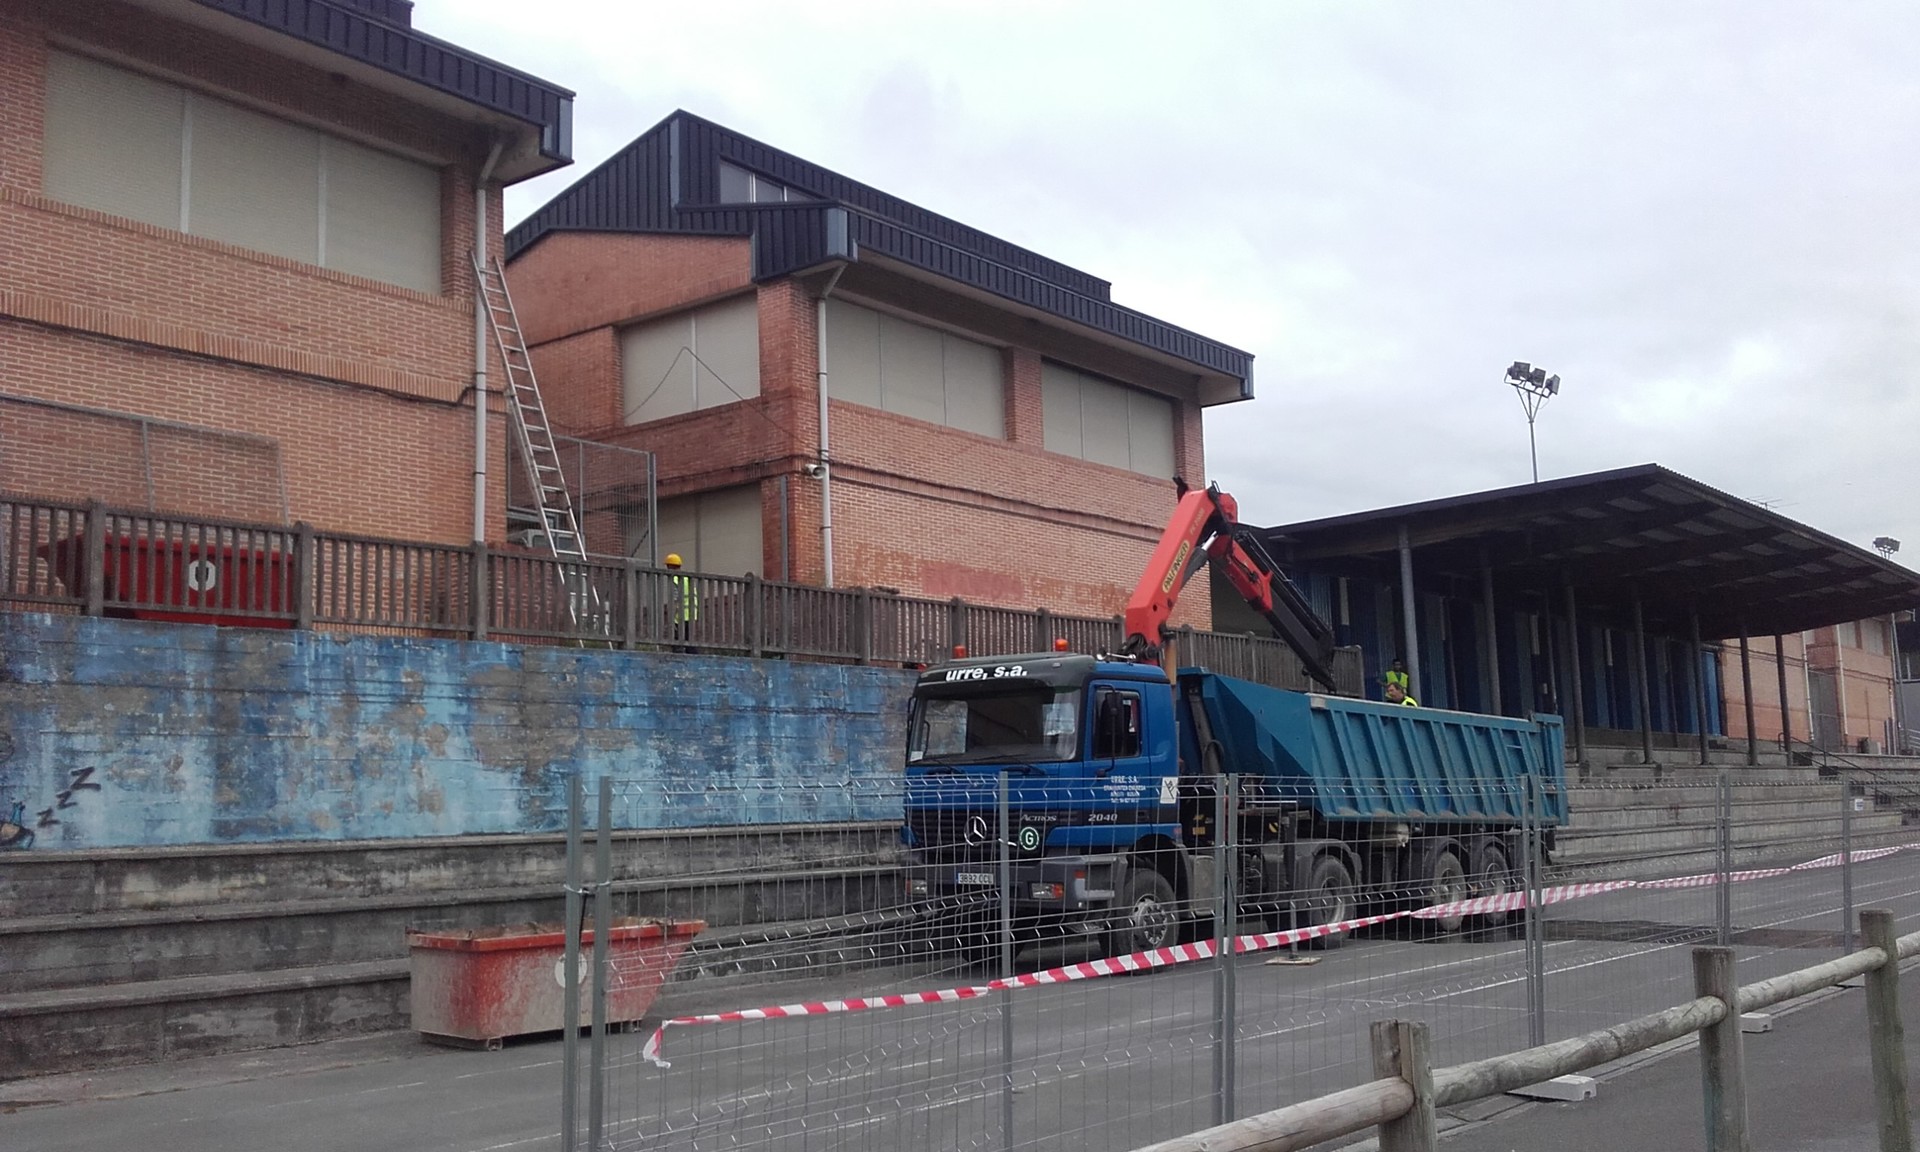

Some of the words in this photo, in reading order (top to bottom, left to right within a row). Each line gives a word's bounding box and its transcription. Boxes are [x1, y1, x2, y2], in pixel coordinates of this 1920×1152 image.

[1163, 541, 1188, 590] PALFINGER
[946, 667, 988, 682] urre,
[993, 665, 1028, 678] s.a.
[1088, 813, 1118, 822] 2040
[1025, 831, 1034, 845] G
